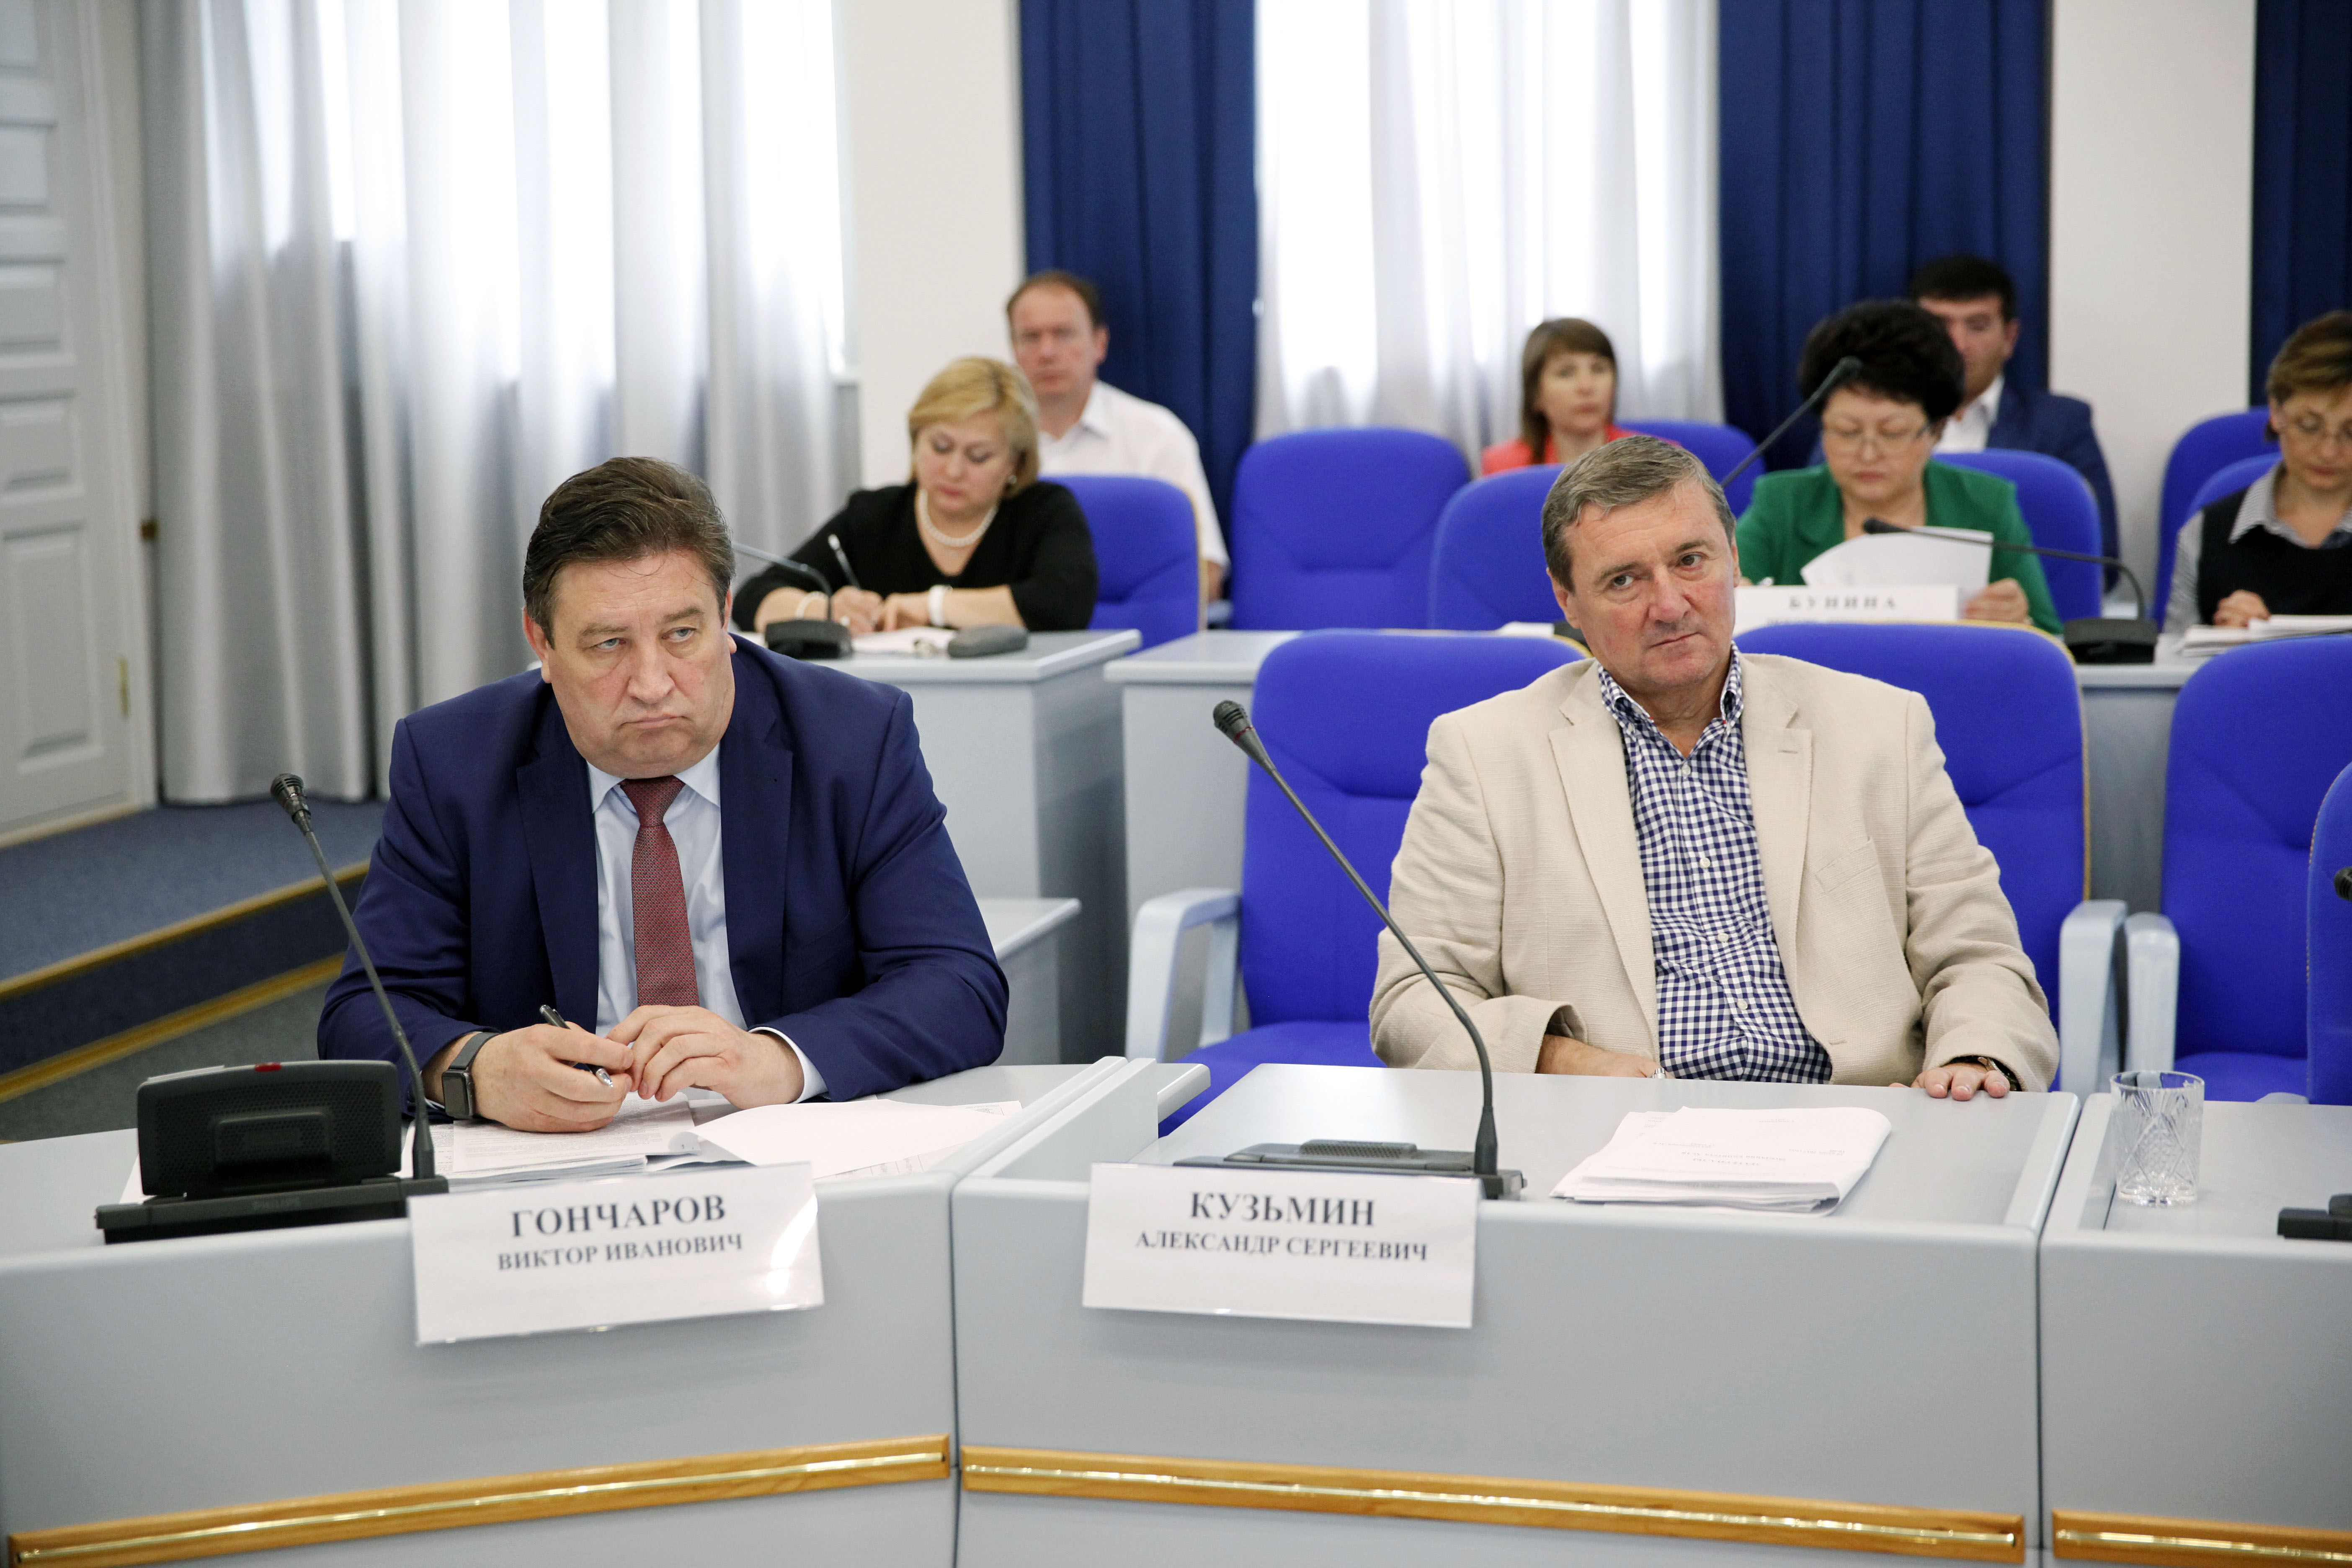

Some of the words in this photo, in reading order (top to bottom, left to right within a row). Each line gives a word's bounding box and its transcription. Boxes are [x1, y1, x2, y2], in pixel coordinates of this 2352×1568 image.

[511, 1194, 726, 1237] ГОНЧАРОВ
[1189, 1191, 1375, 1226] КУЗЬМИН
[498, 1245, 598, 1271] ВИКТОР
[606, 1233, 743, 1261] ИВАНОВИЧ
[1135, 1230, 1280, 1256] АЛЕКСАНДР
[1287, 1236, 1428, 1261] СЕРГЕЕВИЧ
